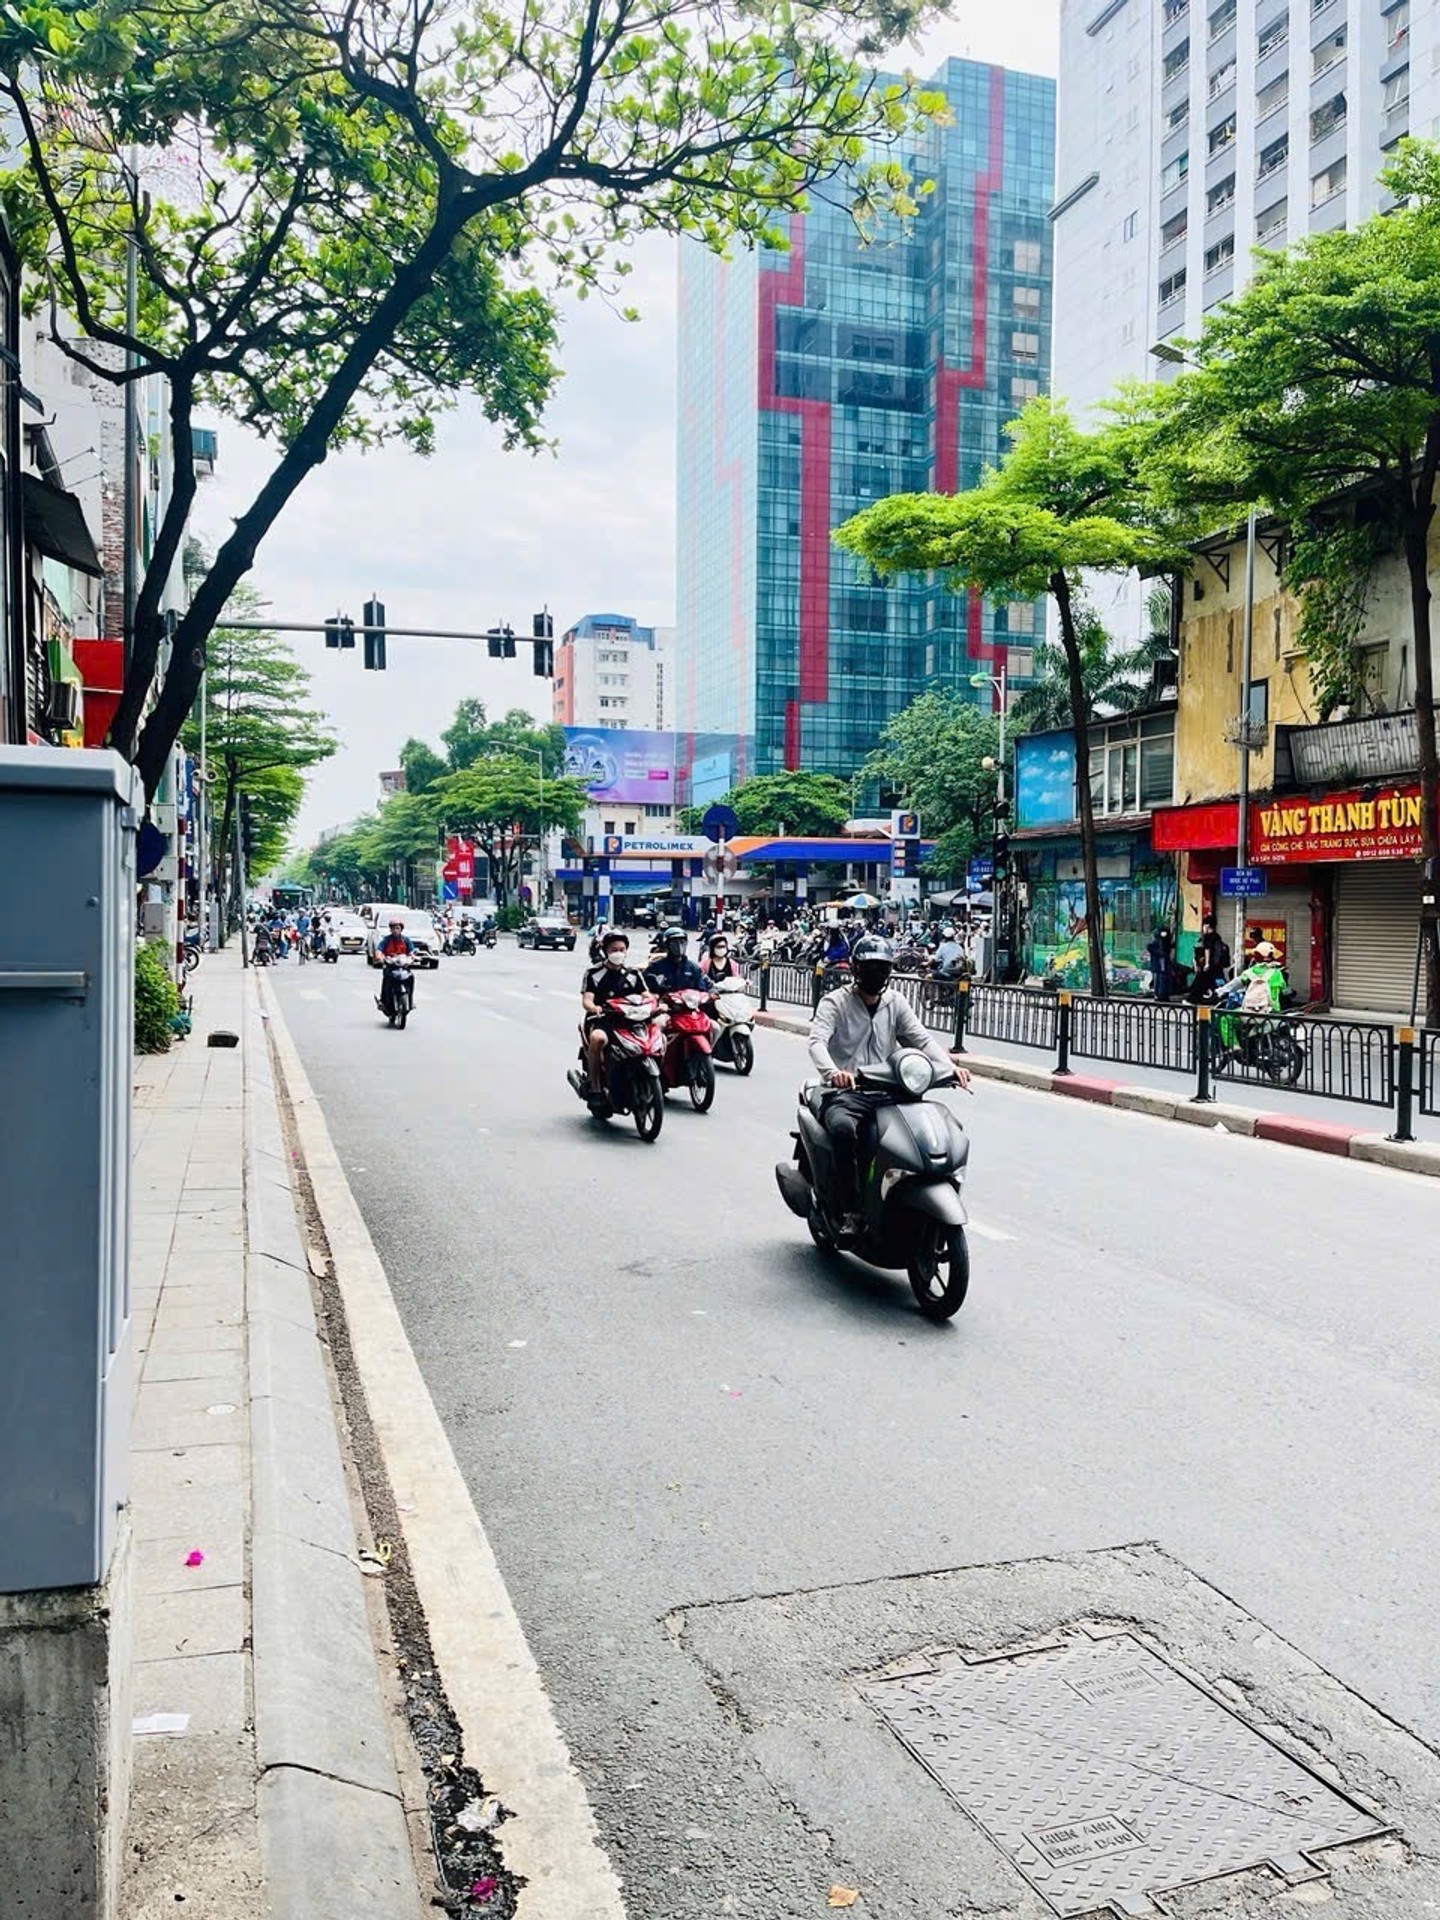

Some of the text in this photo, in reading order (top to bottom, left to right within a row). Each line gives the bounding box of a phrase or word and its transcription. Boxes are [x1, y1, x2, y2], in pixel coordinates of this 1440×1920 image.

[1260, 790, 1422, 837] VÀNG THANH TÙN
[624, 841, 694, 851] PETROLIMEX
